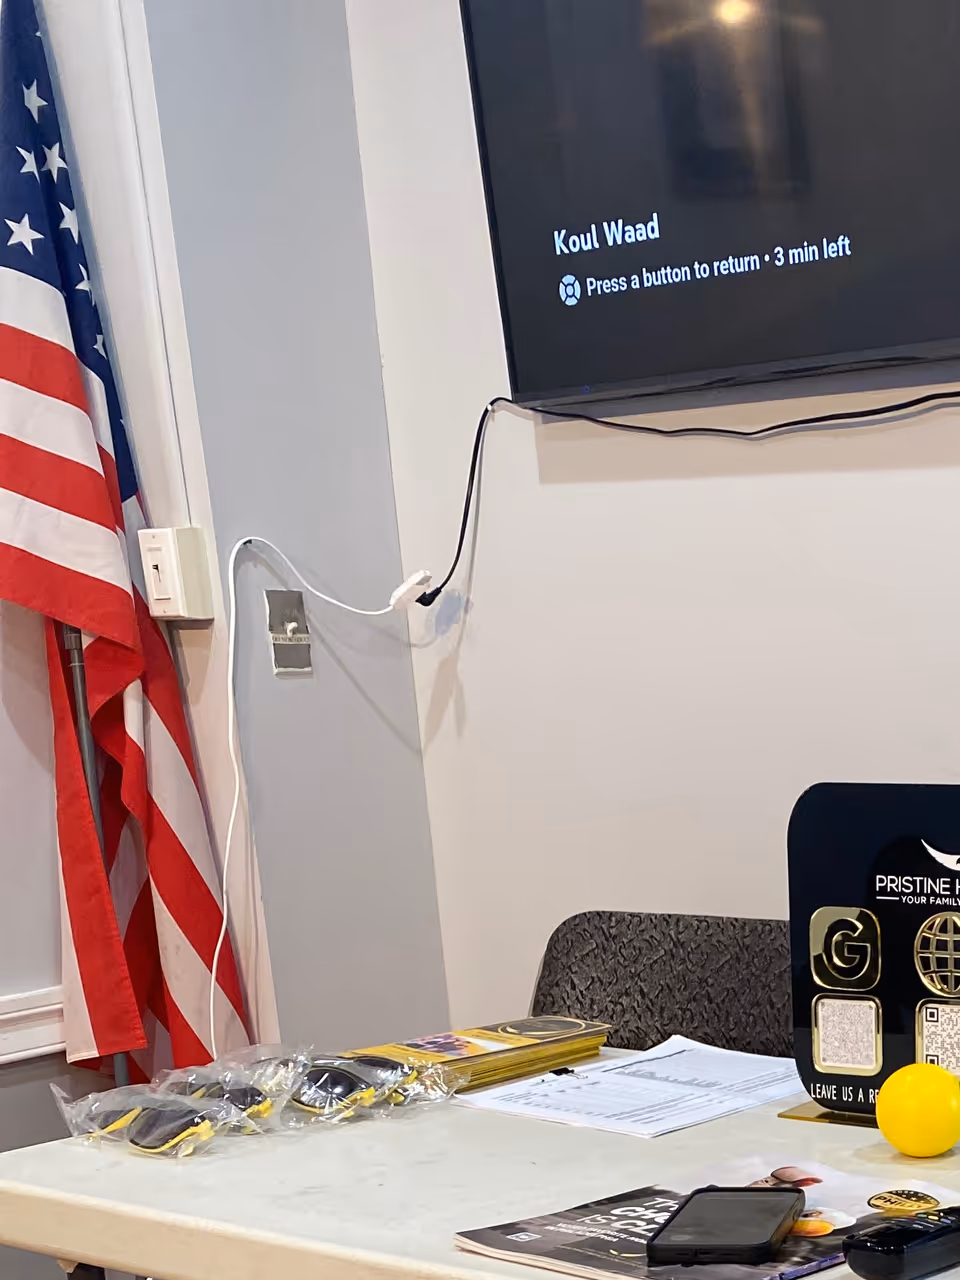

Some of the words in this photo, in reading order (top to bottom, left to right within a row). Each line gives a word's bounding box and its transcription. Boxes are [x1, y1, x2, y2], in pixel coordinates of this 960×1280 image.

[554, 224, 600, 255] Koul
[602, 212, 660, 246] Waad
[586, 277, 628, 297] Press
[630, 274, 640, 289] a
[642, 267, 691, 288] button
[693, 261, 710, 279] to
[713, 254, 761, 277] return
[773, 246, 785, 267] 3
[788, 241, 820, 265] min
[822, 234, 852, 259] left
[875, 875, 951, 895] PRISTINE
[901, 895, 927, 905] YOUR
[810, 1083, 837, 1100] LEAVE
[842, 1086, 853, 1101] US
[857, 1088, 864, 1103] A
[643, 1197, 680, 1210] TH
[577, 1214, 617, 1224] IS
